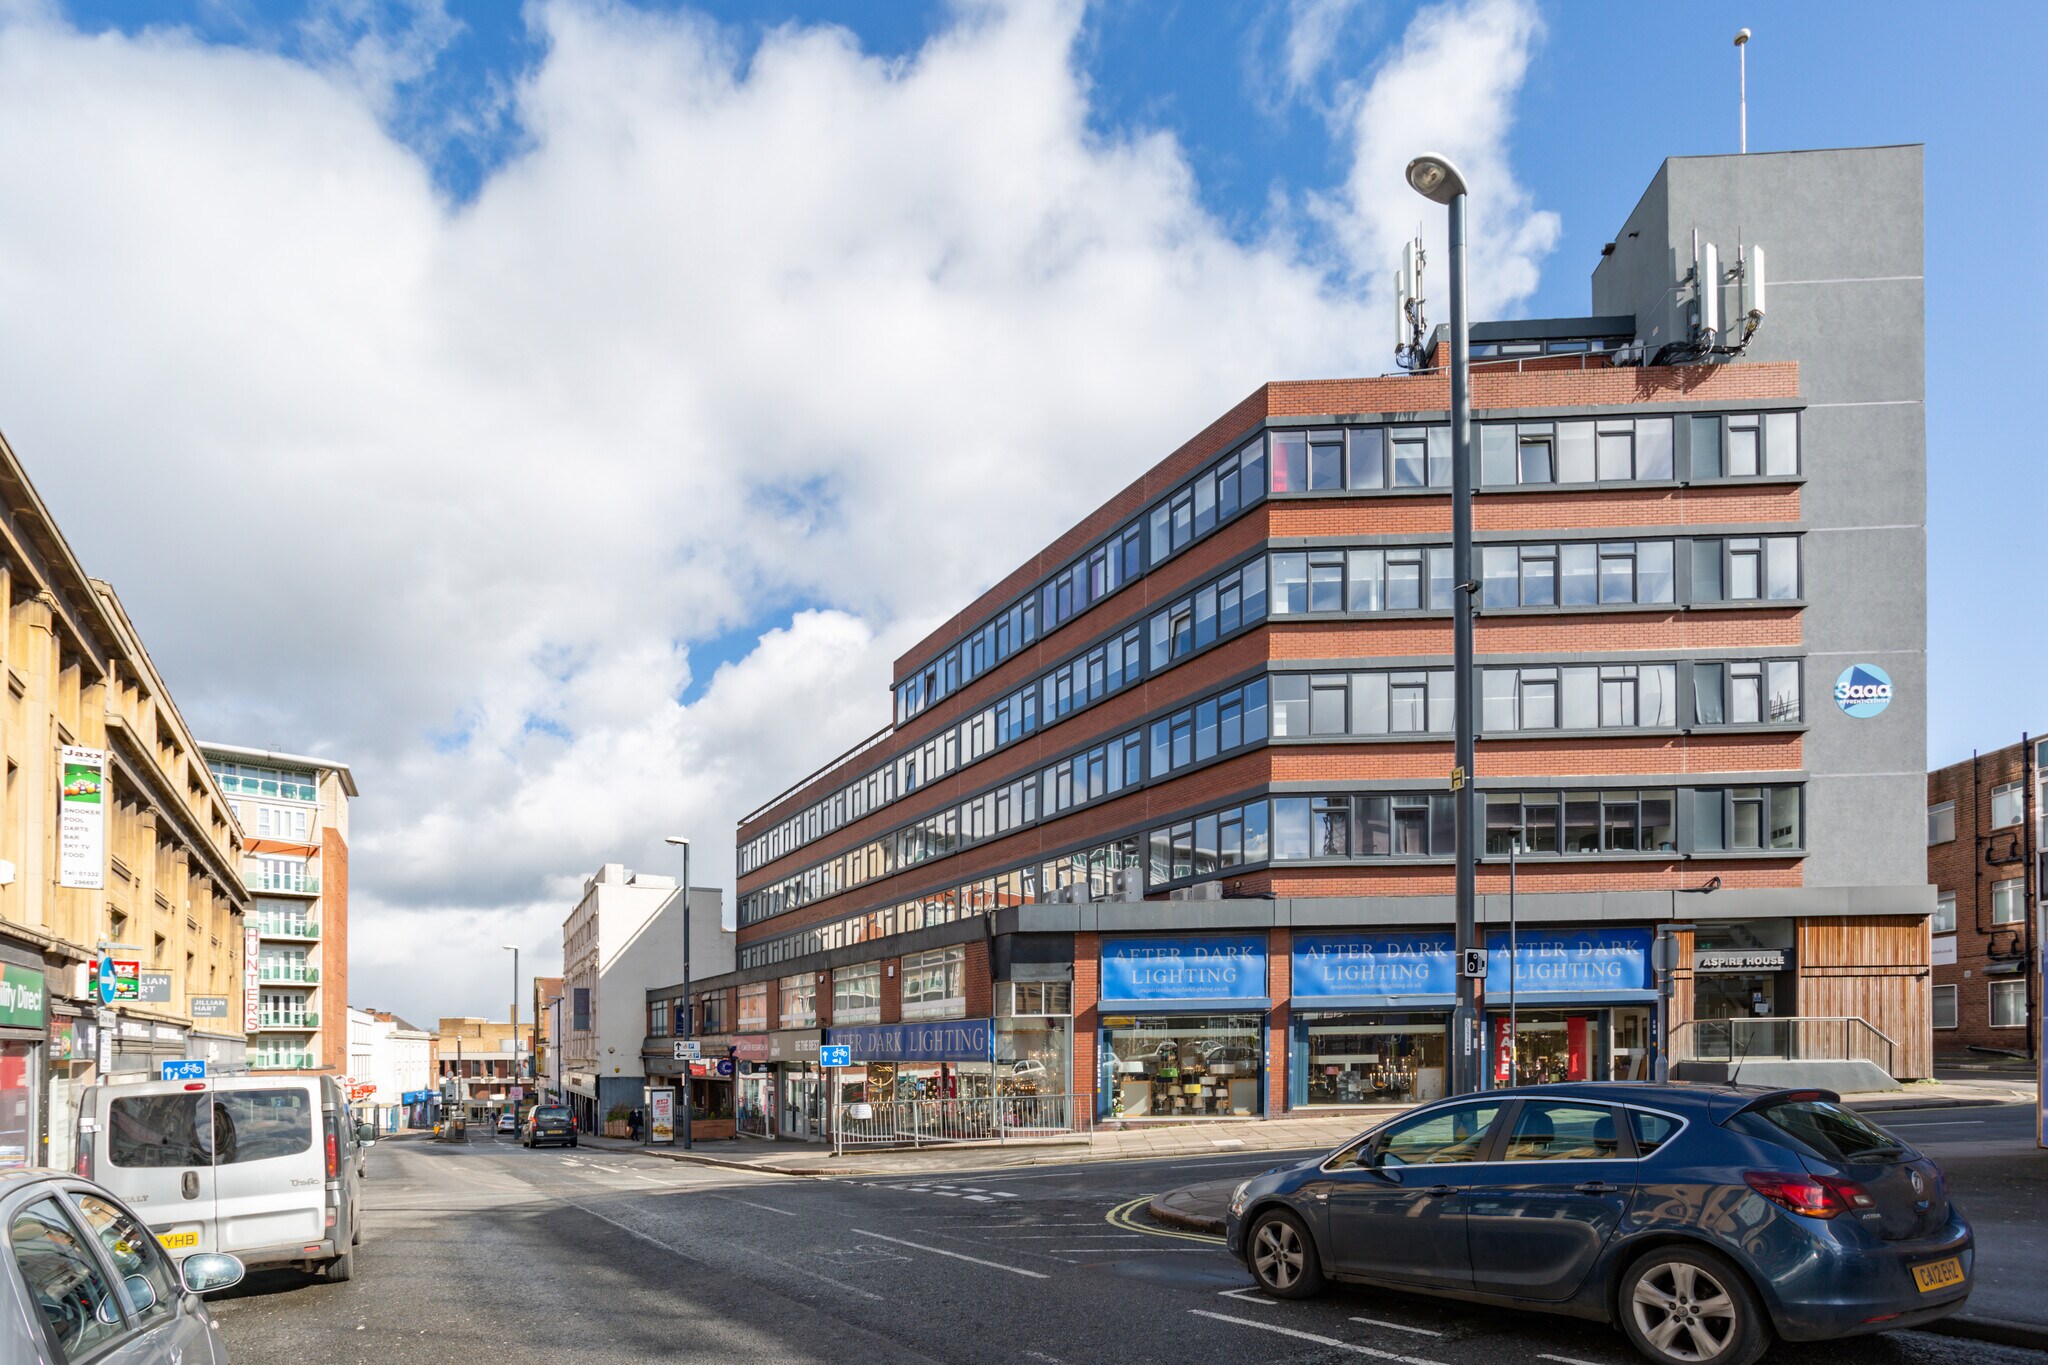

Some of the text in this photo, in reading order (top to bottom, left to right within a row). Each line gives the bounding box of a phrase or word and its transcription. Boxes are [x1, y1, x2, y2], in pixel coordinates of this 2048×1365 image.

[64, 749, 102, 759] Jaxx
[1451, 769, 1463, 789] H
[1113, 946, 1255, 964] AFTER DARK
[1304, 941, 1448, 960] AFTER DARK
[1496, 940, 1641, 958] AFTER DARK
[1515, 961, 1622, 979] LIGHTING
[1703, 956, 1785, 966] ASPIRE HOUSE
[247, 928, 258, 1031] HUNTERS
[1131, 967, 1237, 985] LIGHTING
[1323, 963, 1430, 981] LIGHTING
[17, 983, 42, 1011] Direct
[800, 1040, 808, 1051] THE
[808, 1039, 820, 1051] BEST
[829, 1028, 984, 1052] AFTER DARK LIGHTING
[1501, 1023, 1511, 1075] SALE
[165, 1234, 195, 1247] YHB
[1919, 1264, 1943, 1287] CA12
